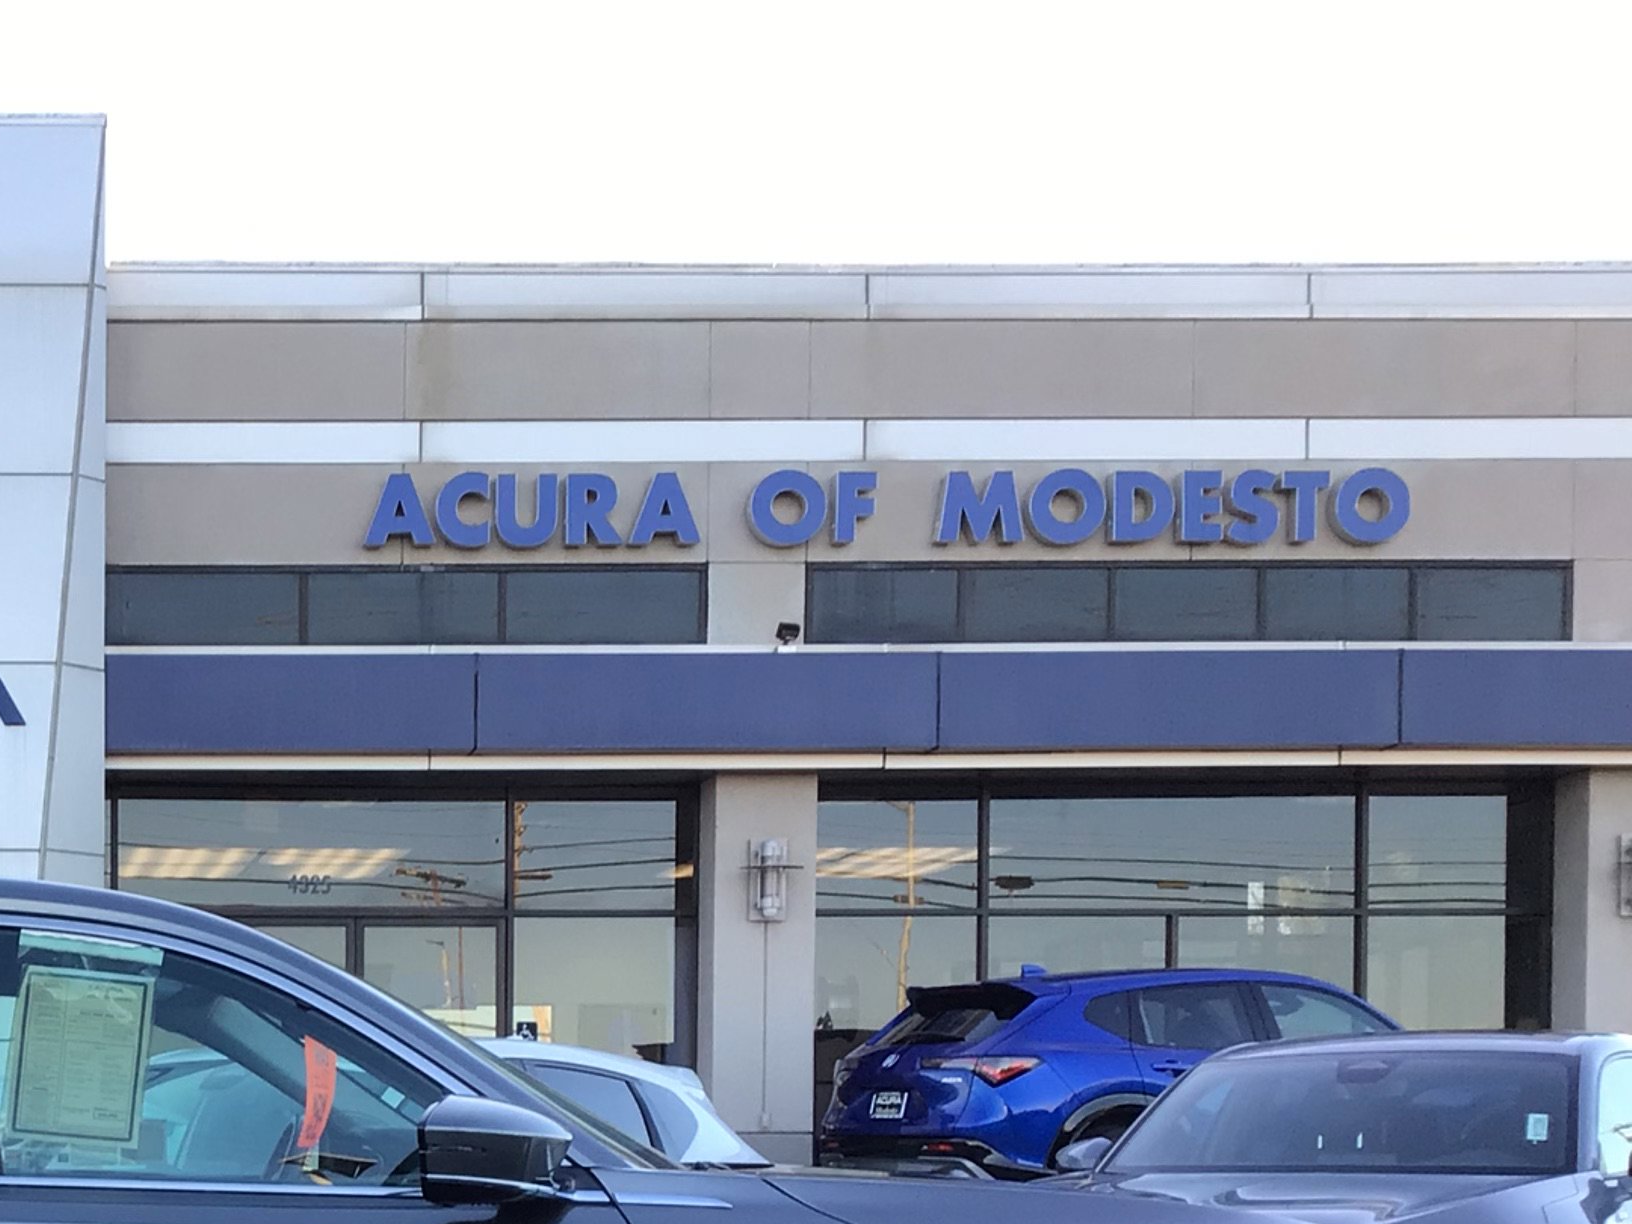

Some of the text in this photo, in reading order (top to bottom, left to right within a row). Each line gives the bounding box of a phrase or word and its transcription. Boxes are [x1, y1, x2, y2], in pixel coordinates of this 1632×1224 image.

[363, 467, 1411, 548] ACURA OF MODESTO
